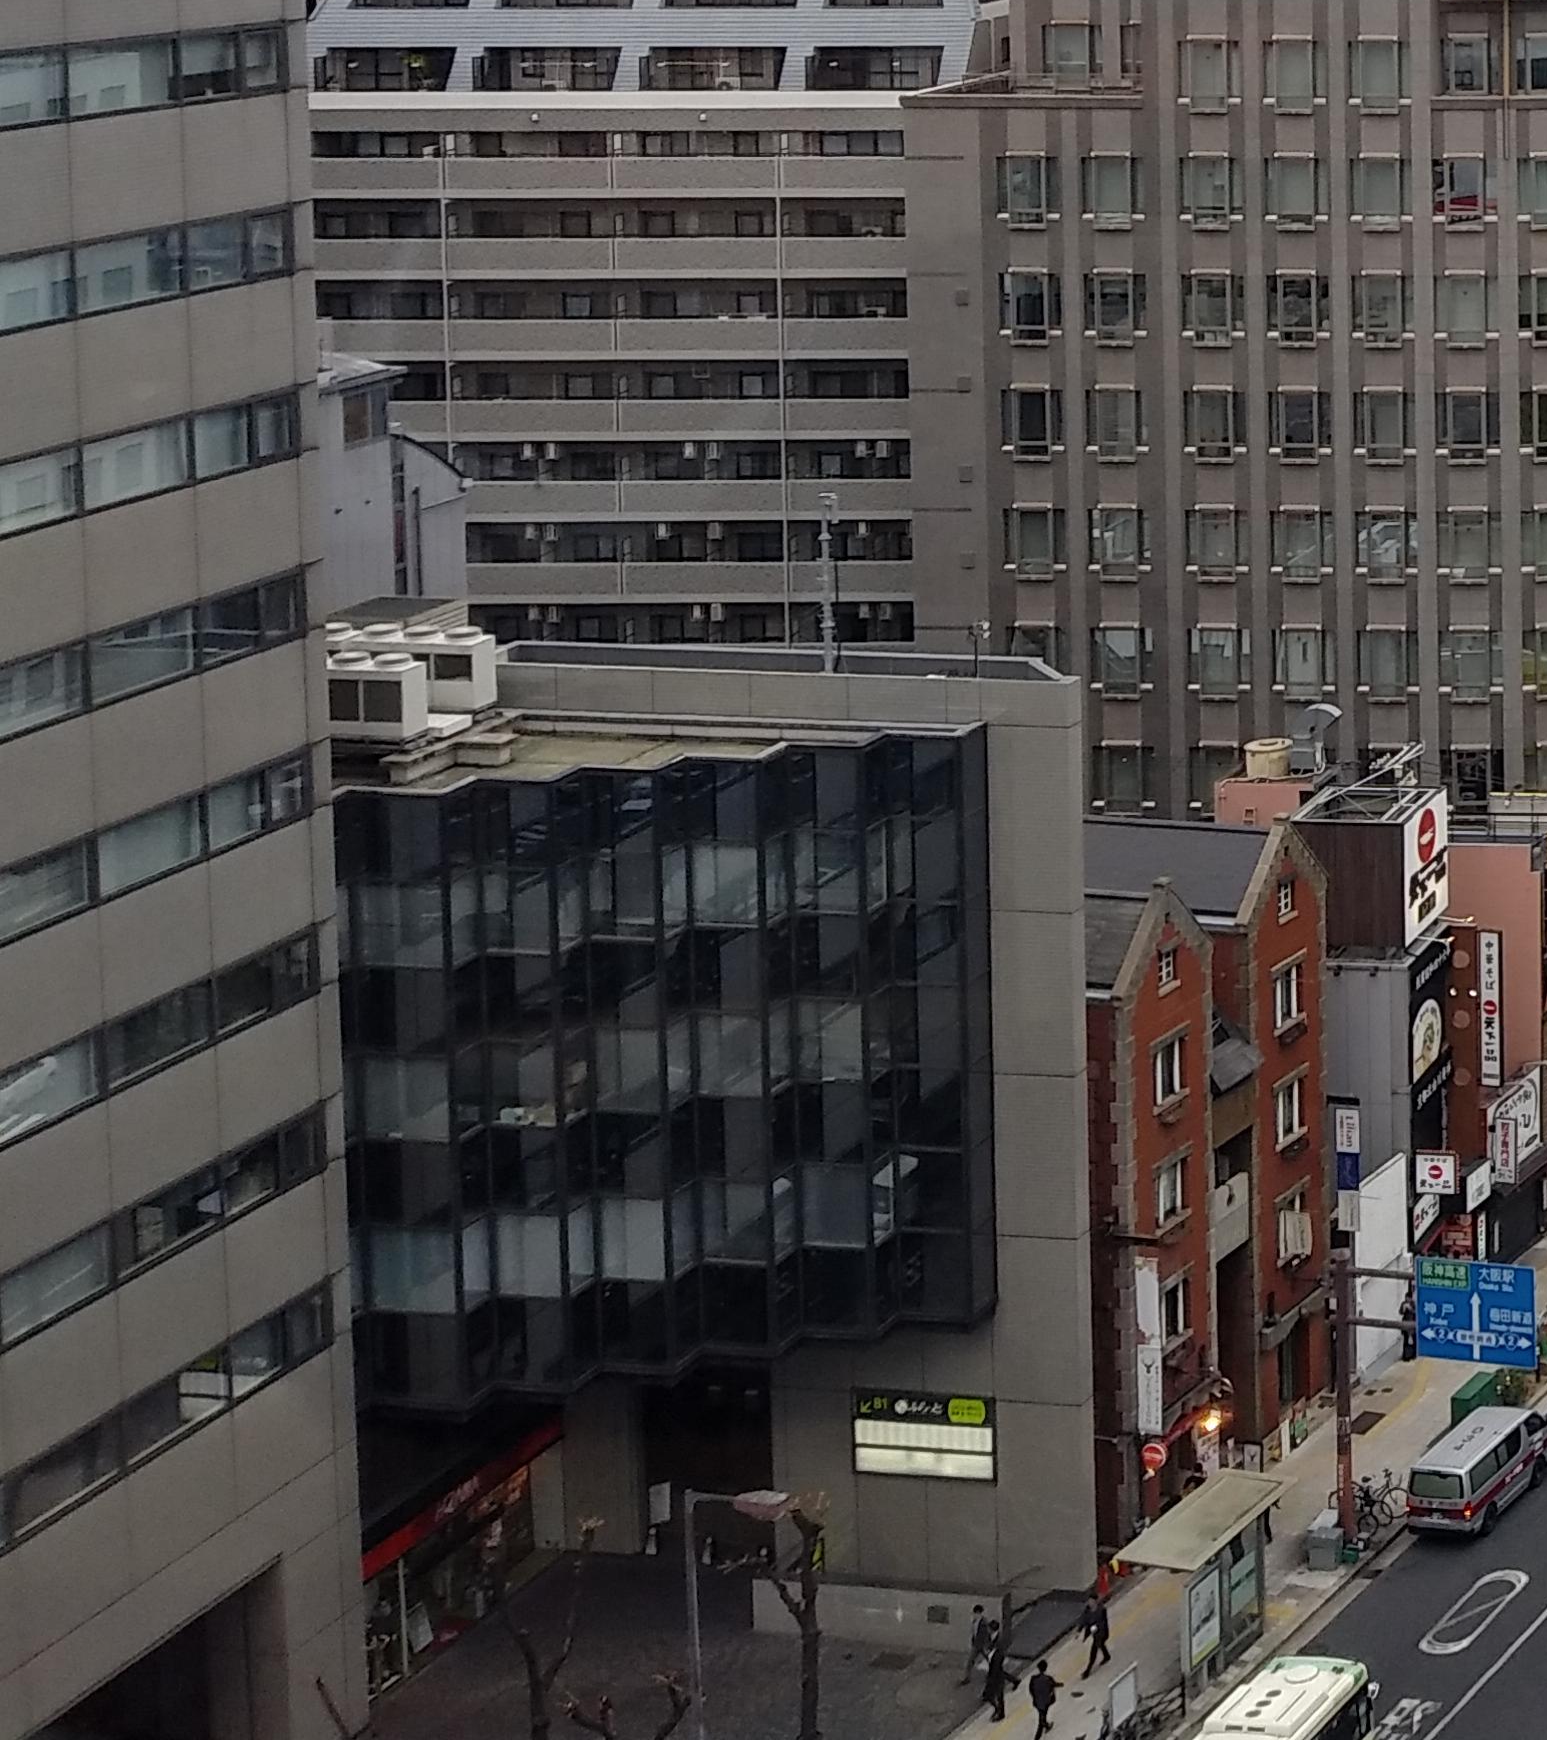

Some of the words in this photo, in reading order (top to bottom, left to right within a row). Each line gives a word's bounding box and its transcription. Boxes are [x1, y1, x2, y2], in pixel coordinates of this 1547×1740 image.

[1484, 940, 1496, 991] 中華そば
[1483, 1016, 1499, 1062] 天下一品
[1421, 1262, 1467, 1279] 阪神高速
[1478, 1267, 1515, 1283] 大阪駅
[1423, 1301, 1455, 1317] 神戸
[1436, 1329, 1446, 1339] 2
[1507, 1335, 1515, 1346] 2
